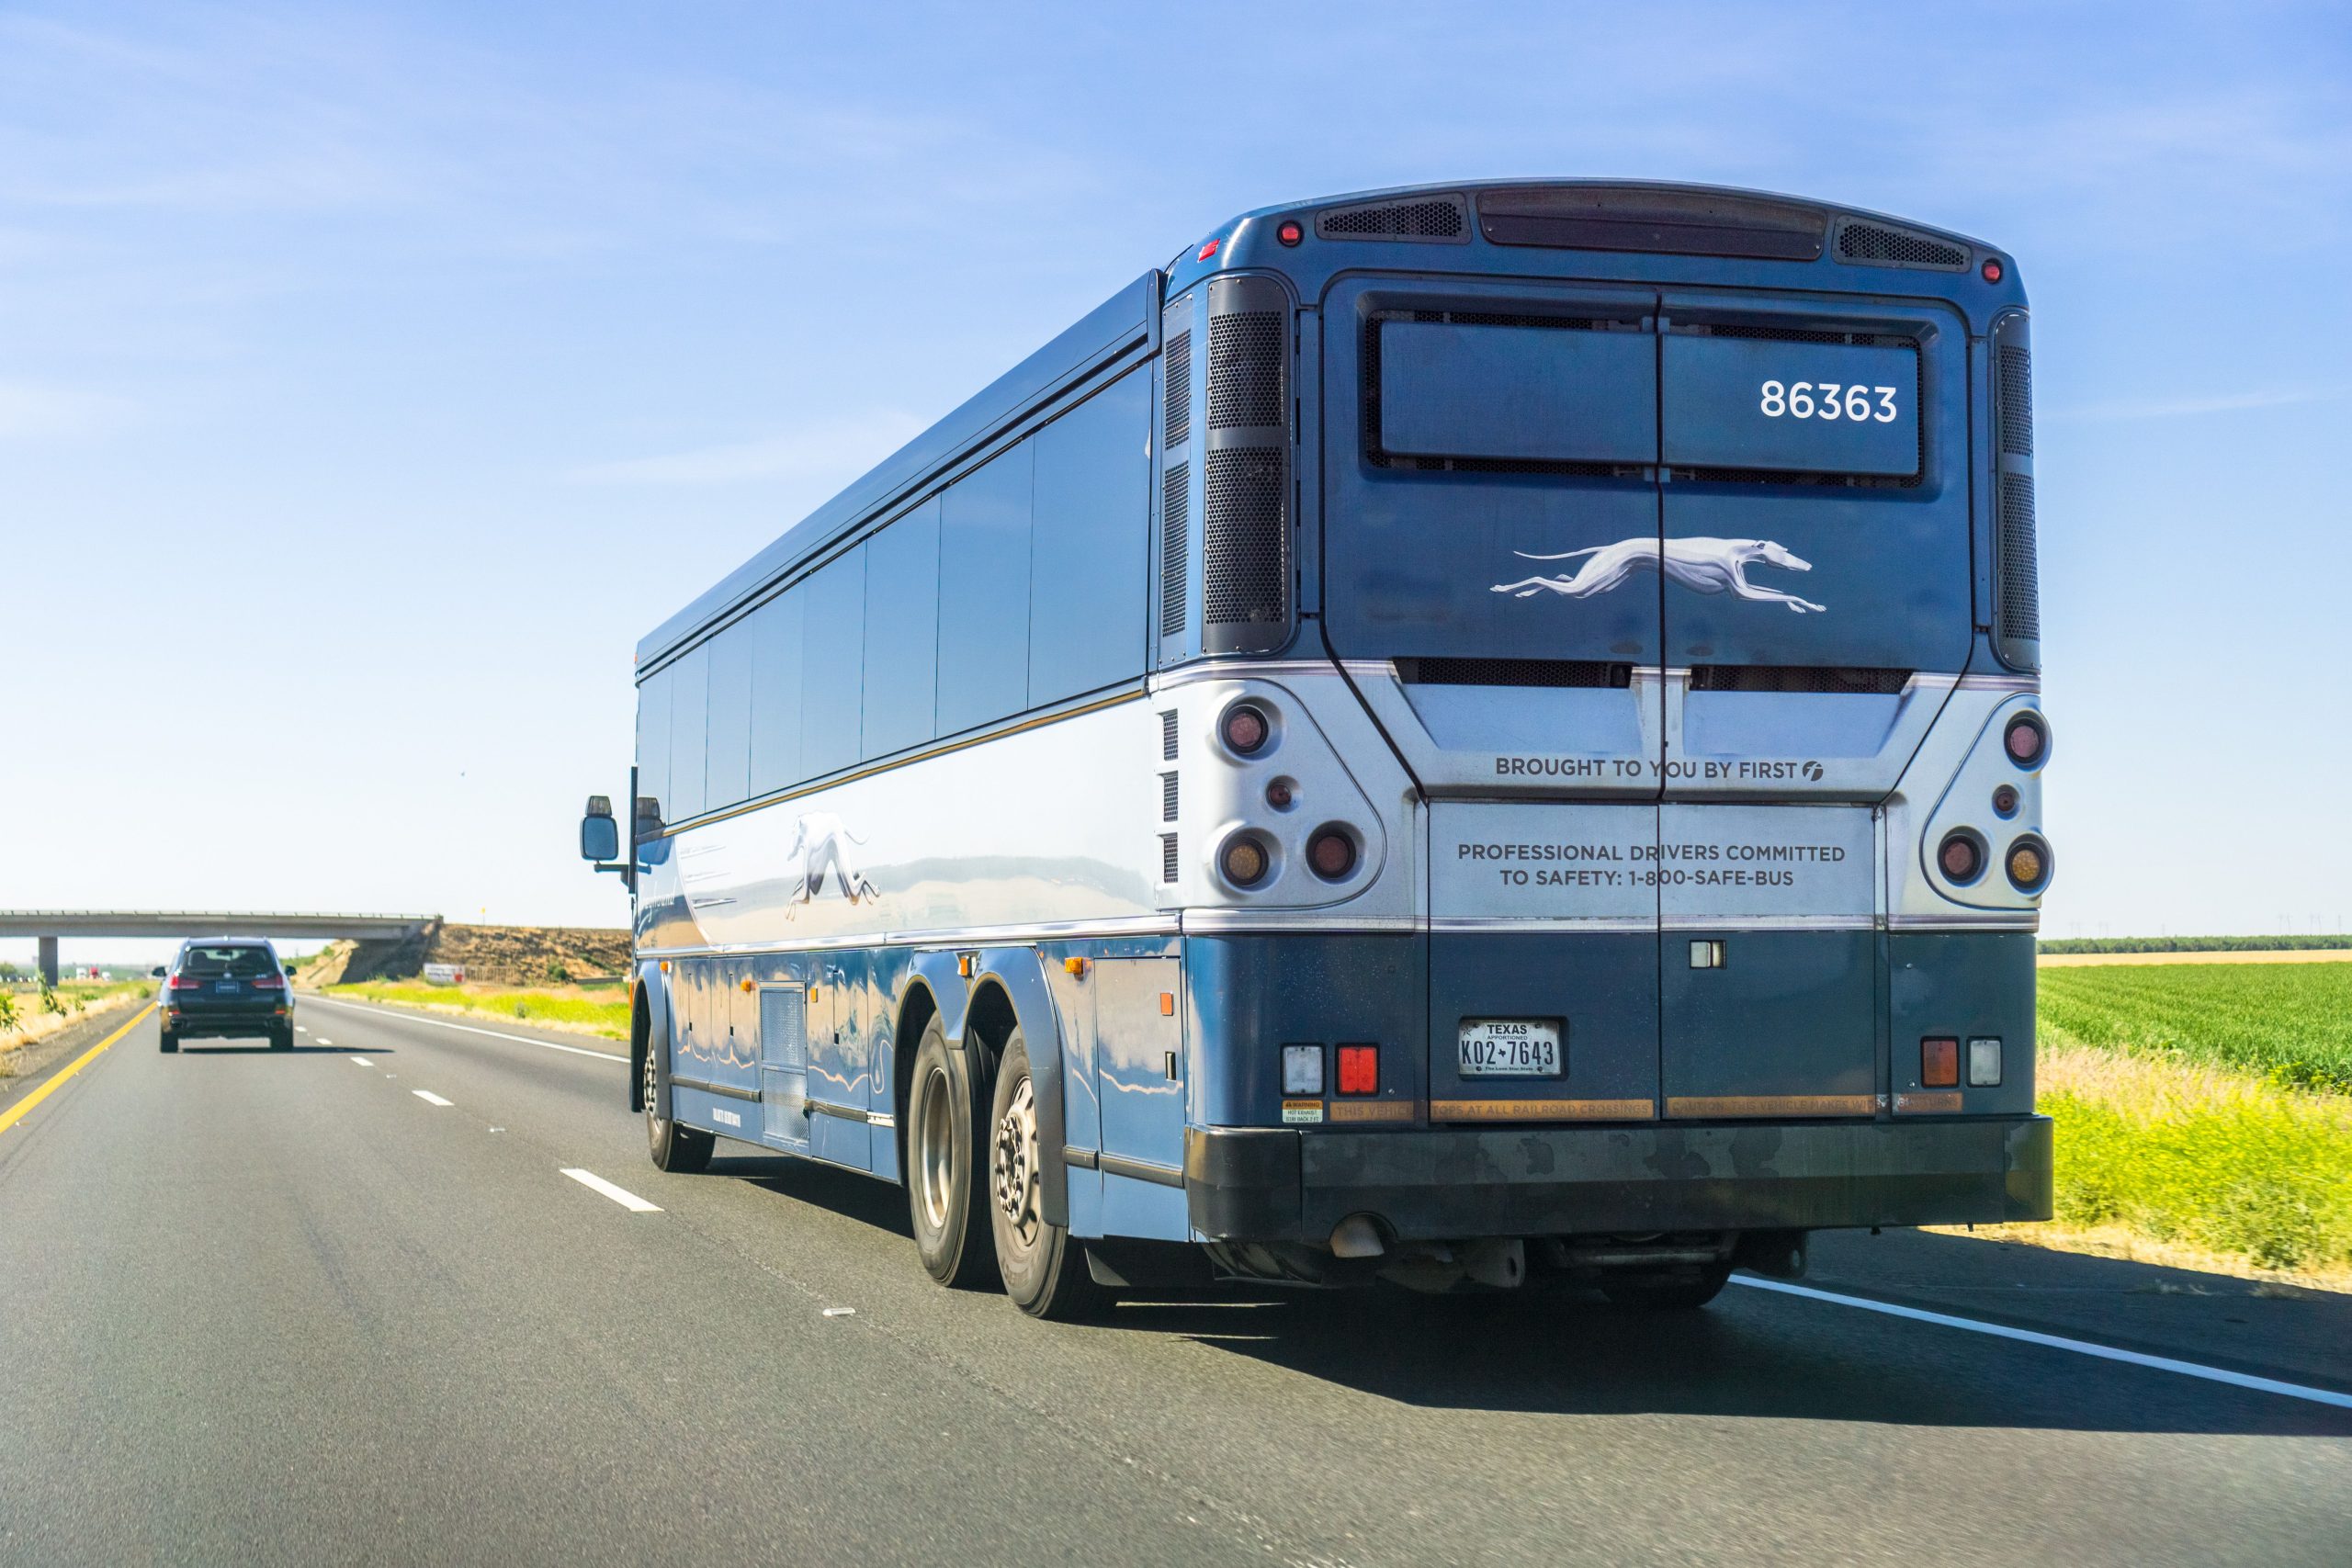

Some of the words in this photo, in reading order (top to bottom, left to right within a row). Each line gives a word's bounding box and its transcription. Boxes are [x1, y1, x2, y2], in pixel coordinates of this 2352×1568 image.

[1760, 379, 1897, 423] 86363
[1495, 757, 1604, 777] BROUGHT
[1612, 760, 1642, 778] TO
[1649, 760, 1697, 779] YOU
[1704, 761, 1731, 779] BY
[1738, 761, 1798, 780] FIRST
[1458, 844, 1623, 862] PROFESSIONAL
[1630, 844, 1720, 862] DRIVERS
[1726, 845, 1846, 863] COMMITTED
[1500, 869, 1530, 886] TO
[1535, 869, 1623, 887] SAFETY:
[1629, 869, 1794, 887] 1-800-SAFE-BUS
[1487, 1024, 1528, 1035] TEXAS
[1337, 1106, 1364, 1117] THIS
[1431, 1105, 1464, 1115] TOPS
[1468, 1105, 1482, 1115] AT
[1487, 1105, 1510, 1115] ALL
[1513, 1104, 1576, 1115] RAILROAD
[1579, 1104, 1649, 1114] CROSSINGS
[1760, 1101, 1807, 1111] VEHICLE
[1810, 1100, 1849, 1111] MAKES
